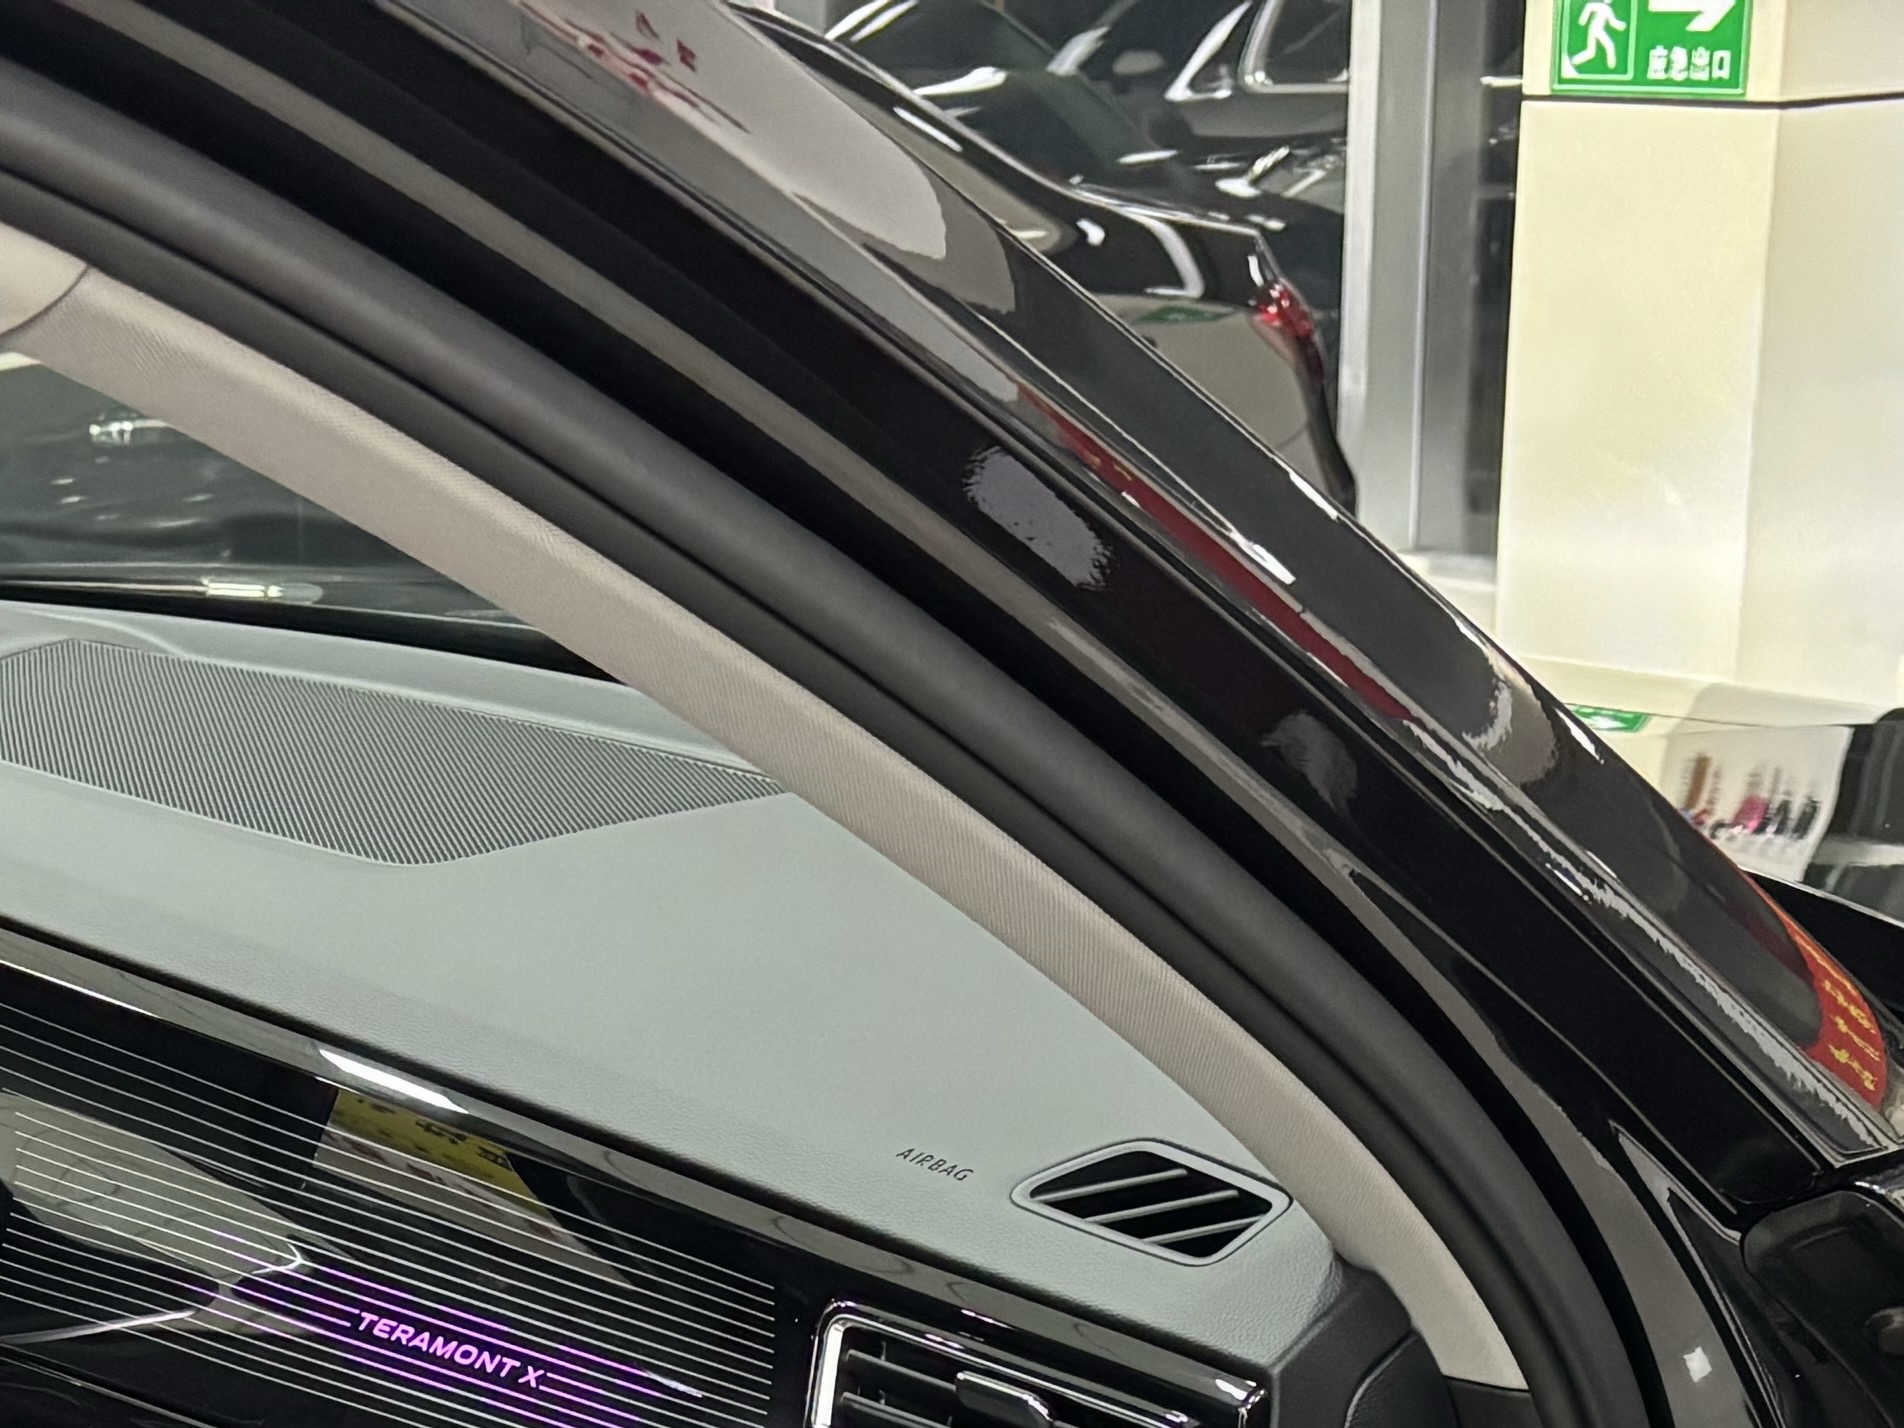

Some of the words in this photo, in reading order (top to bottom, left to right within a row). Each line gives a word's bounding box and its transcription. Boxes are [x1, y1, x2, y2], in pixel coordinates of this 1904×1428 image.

[1647, 45, 1731, 81] 应急出口
[895, 1147, 975, 1181] AIRBAG
[357, 1311, 522, 1378] TERAMONT
[517, 1365, 546, 1389] X
